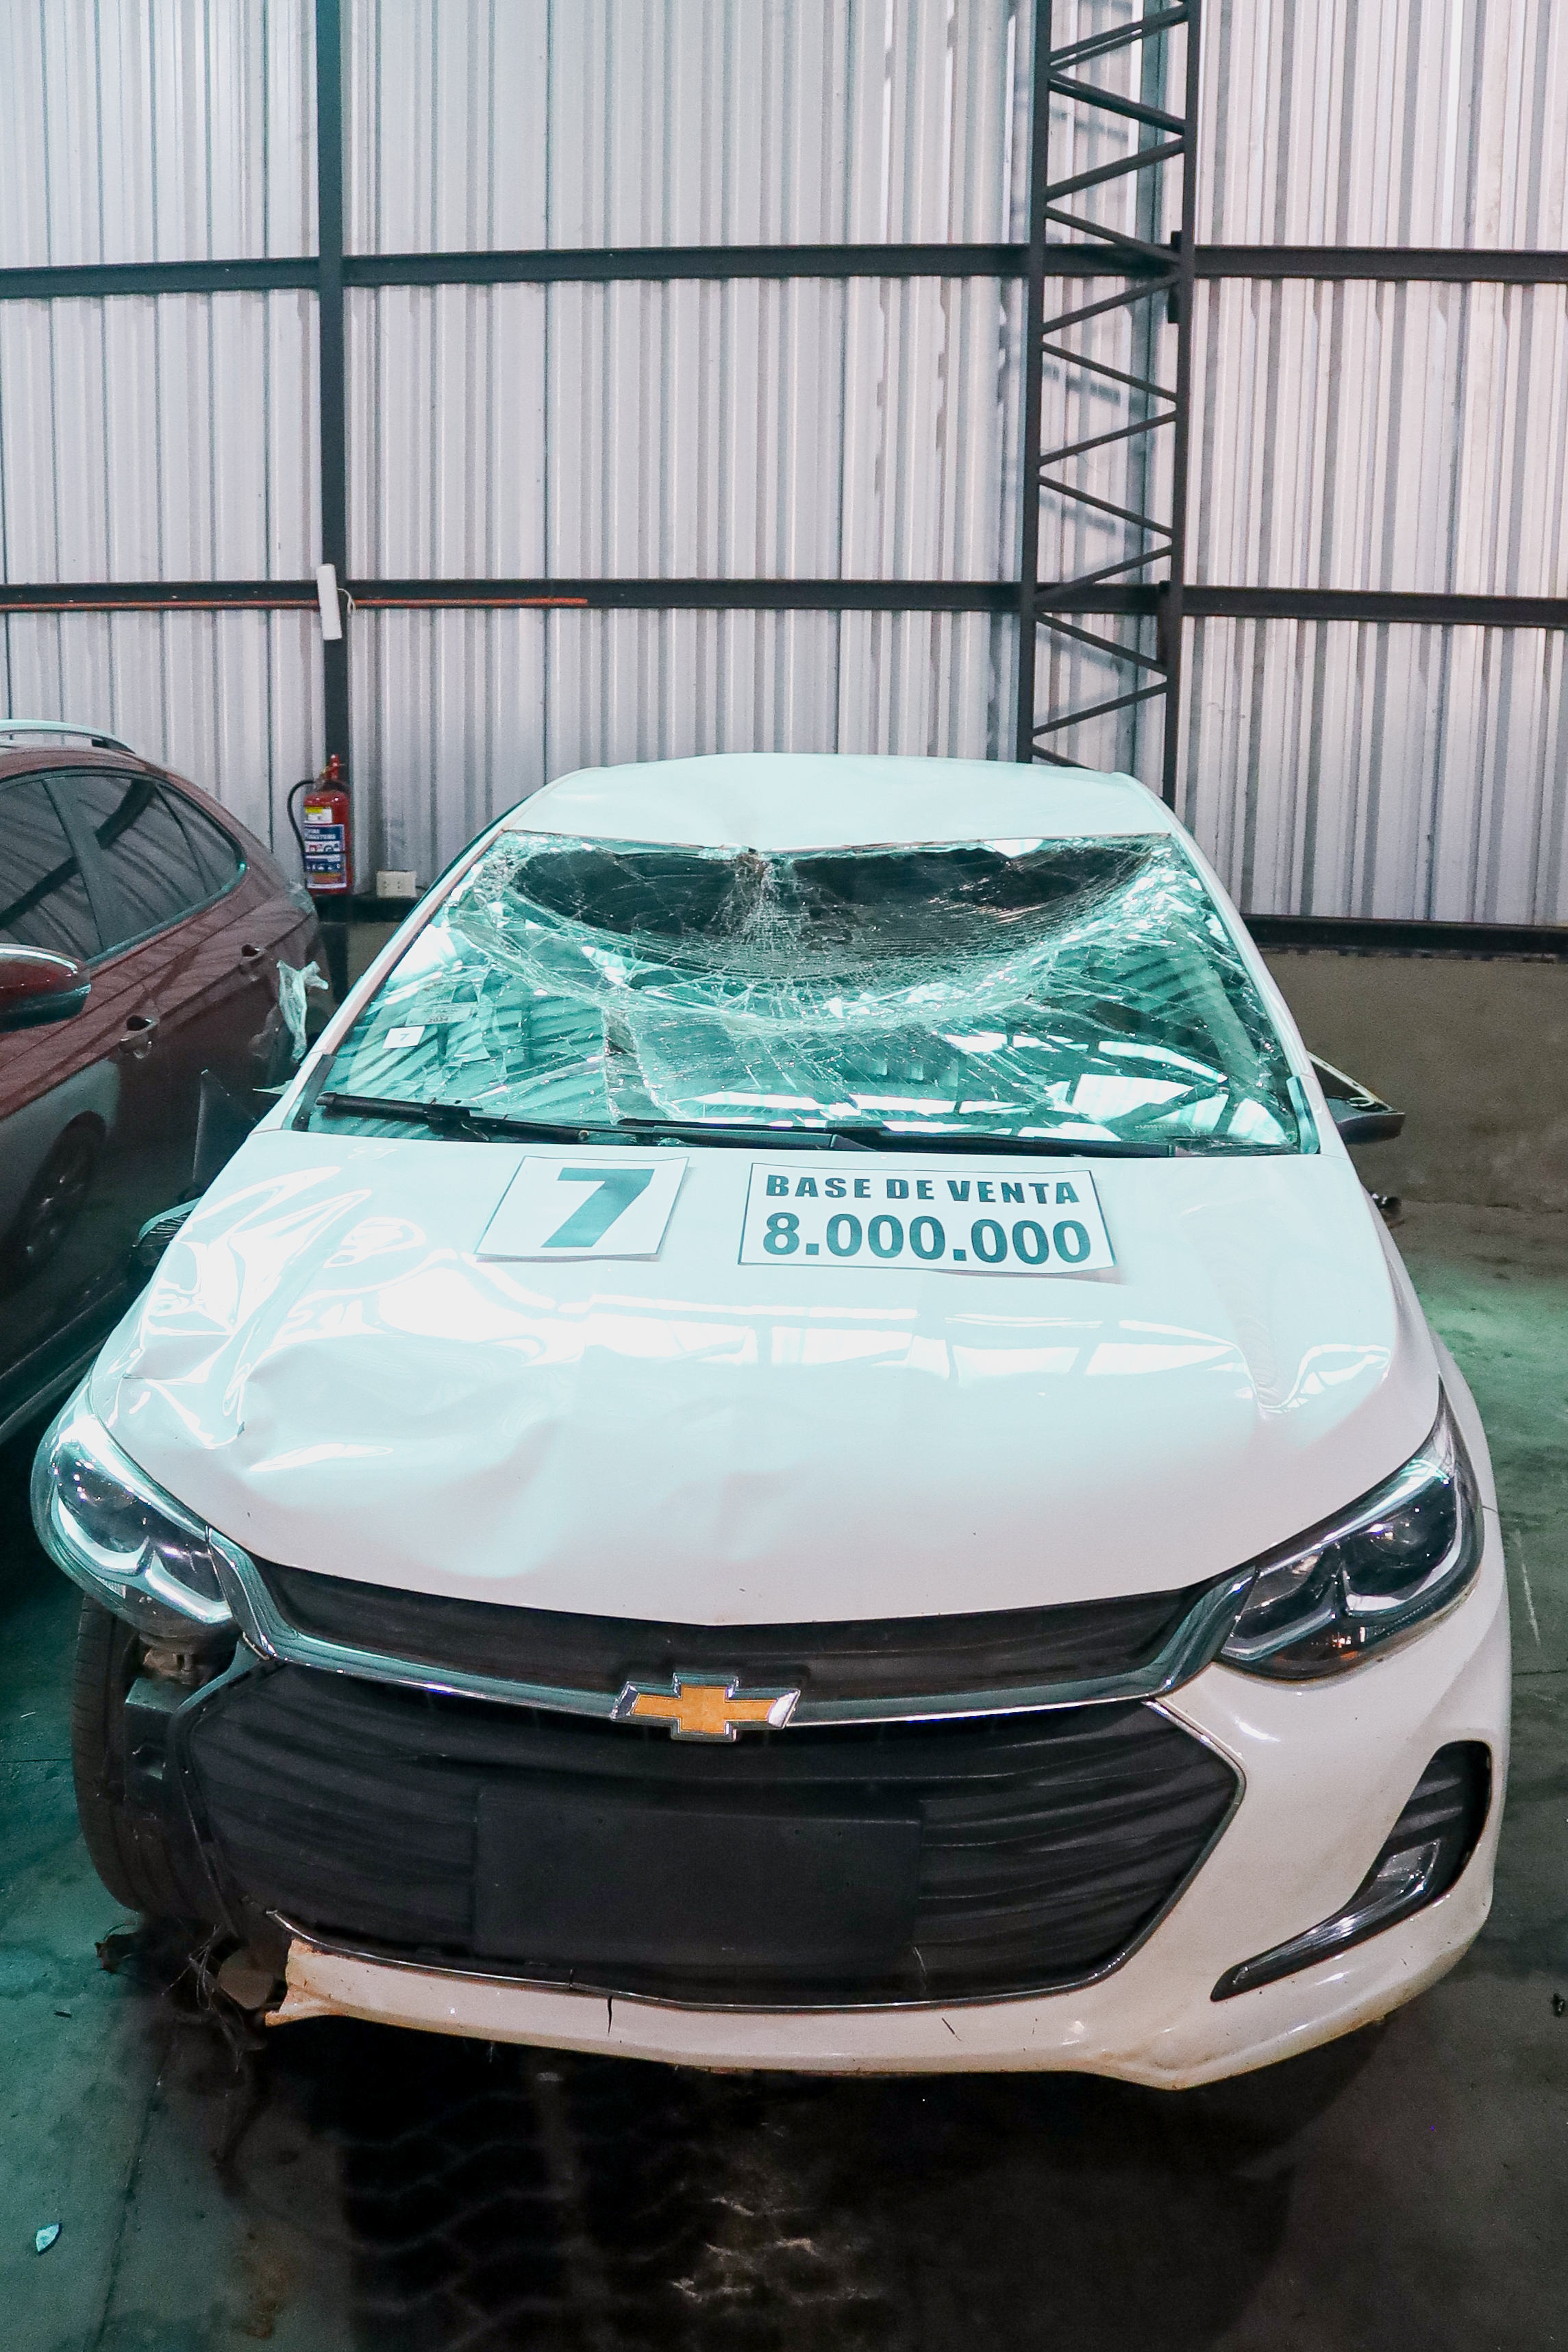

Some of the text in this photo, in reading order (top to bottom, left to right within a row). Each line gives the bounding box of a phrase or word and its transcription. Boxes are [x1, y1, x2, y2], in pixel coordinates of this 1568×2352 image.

[400, 1033, 410, 1041] 7
[542, 1167, 656, 1248] 7
[765, 1174, 1080, 1205] BASE DE VENTA
[762, 1211, 1092, 1265] 8.000.000
